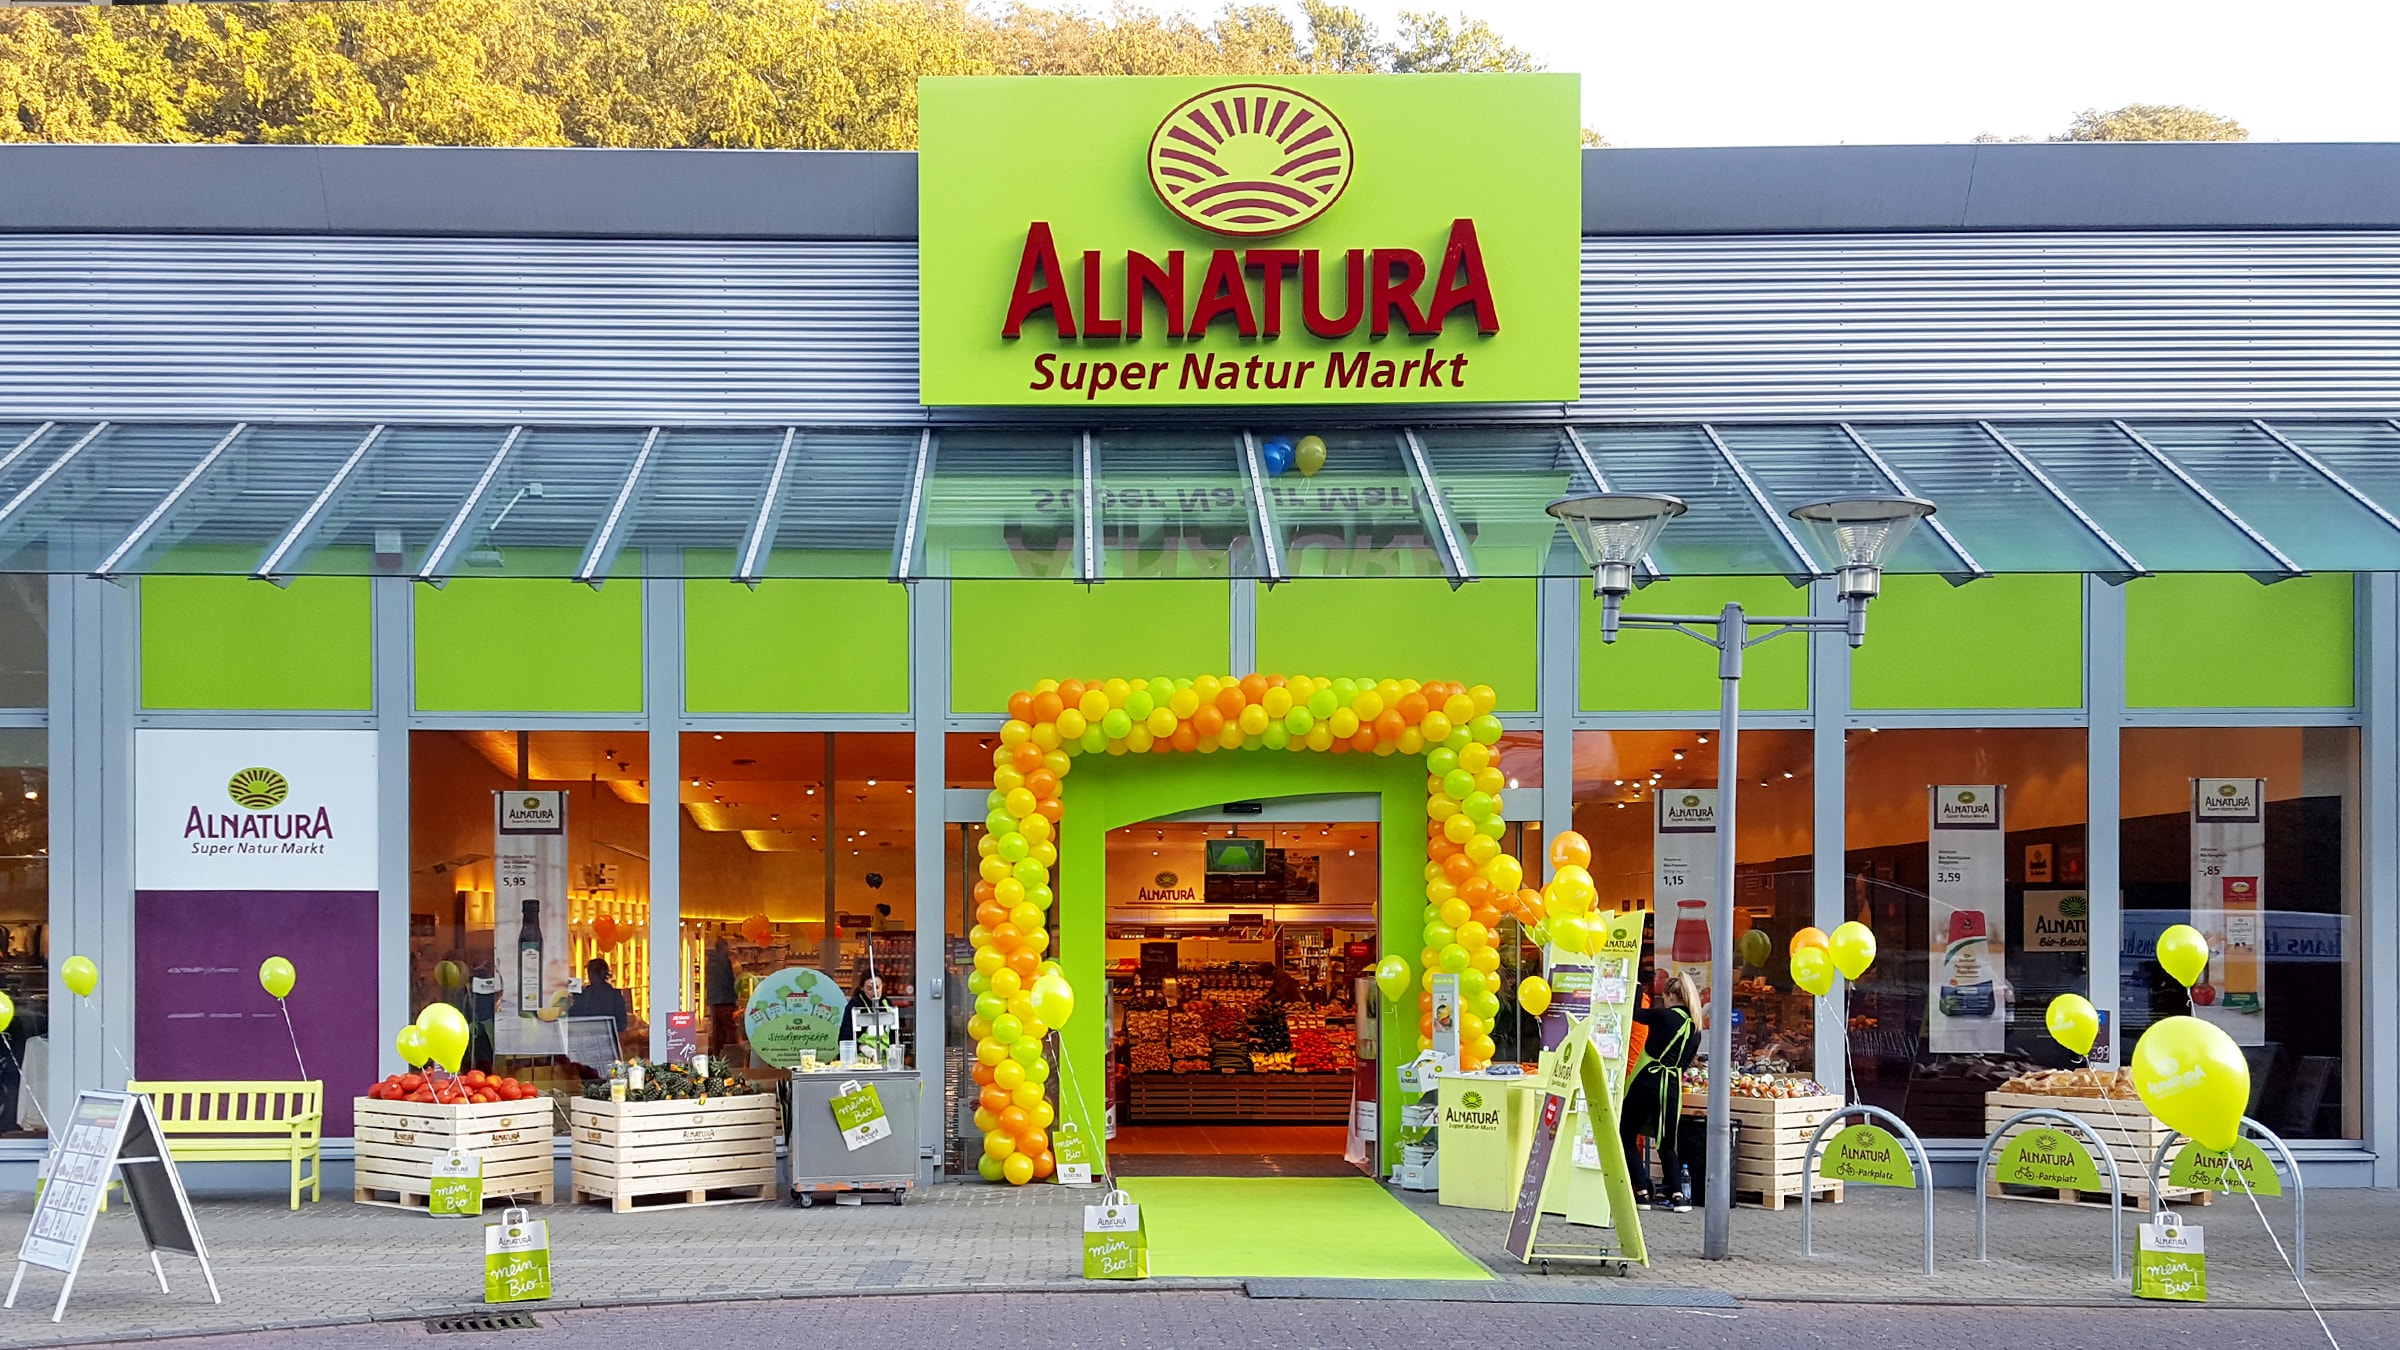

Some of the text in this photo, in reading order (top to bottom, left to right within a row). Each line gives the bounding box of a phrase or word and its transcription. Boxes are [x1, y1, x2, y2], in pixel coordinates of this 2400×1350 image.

[1002, 218, 1500, 340] ALNATURA
[1029, 348, 1469, 400] Super Natur Markt
[1943, 803, 1990, 814] ALNATURA
[2205, 796, 2251, 807] ALNATURA
[508, 808, 554, 819] ALNATURA
[1668, 806, 1714, 817] ALNATURA
[183, 805, 334, 839] ALNATURA
[191, 842, 325, 857] Super Natur Markt
[503, 877, 526, 887] 5,95
[1663, 875, 1684, 886] 1,15
[1937, 872, 1961, 883] 3,59
[1138, 887, 1195, 901] ALNATURA
[1603, 939, 1638, 949] LNATURA
[838, 1096, 871, 1115] mein
[1446, 1107, 1499, 1125] ALNATURA
[1056, 1136, 1082, 1148] mein
[1841, 1144, 1891, 1163] ALNATURA
[2019, 1148, 2075, 1167] ALNATURA
[435, 1181, 471, 1196] mein
[1089, 1237, 1129, 1257] mein
[490, 1256, 539, 1280] mein
[2146, 1256, 2194, 1276] mein
